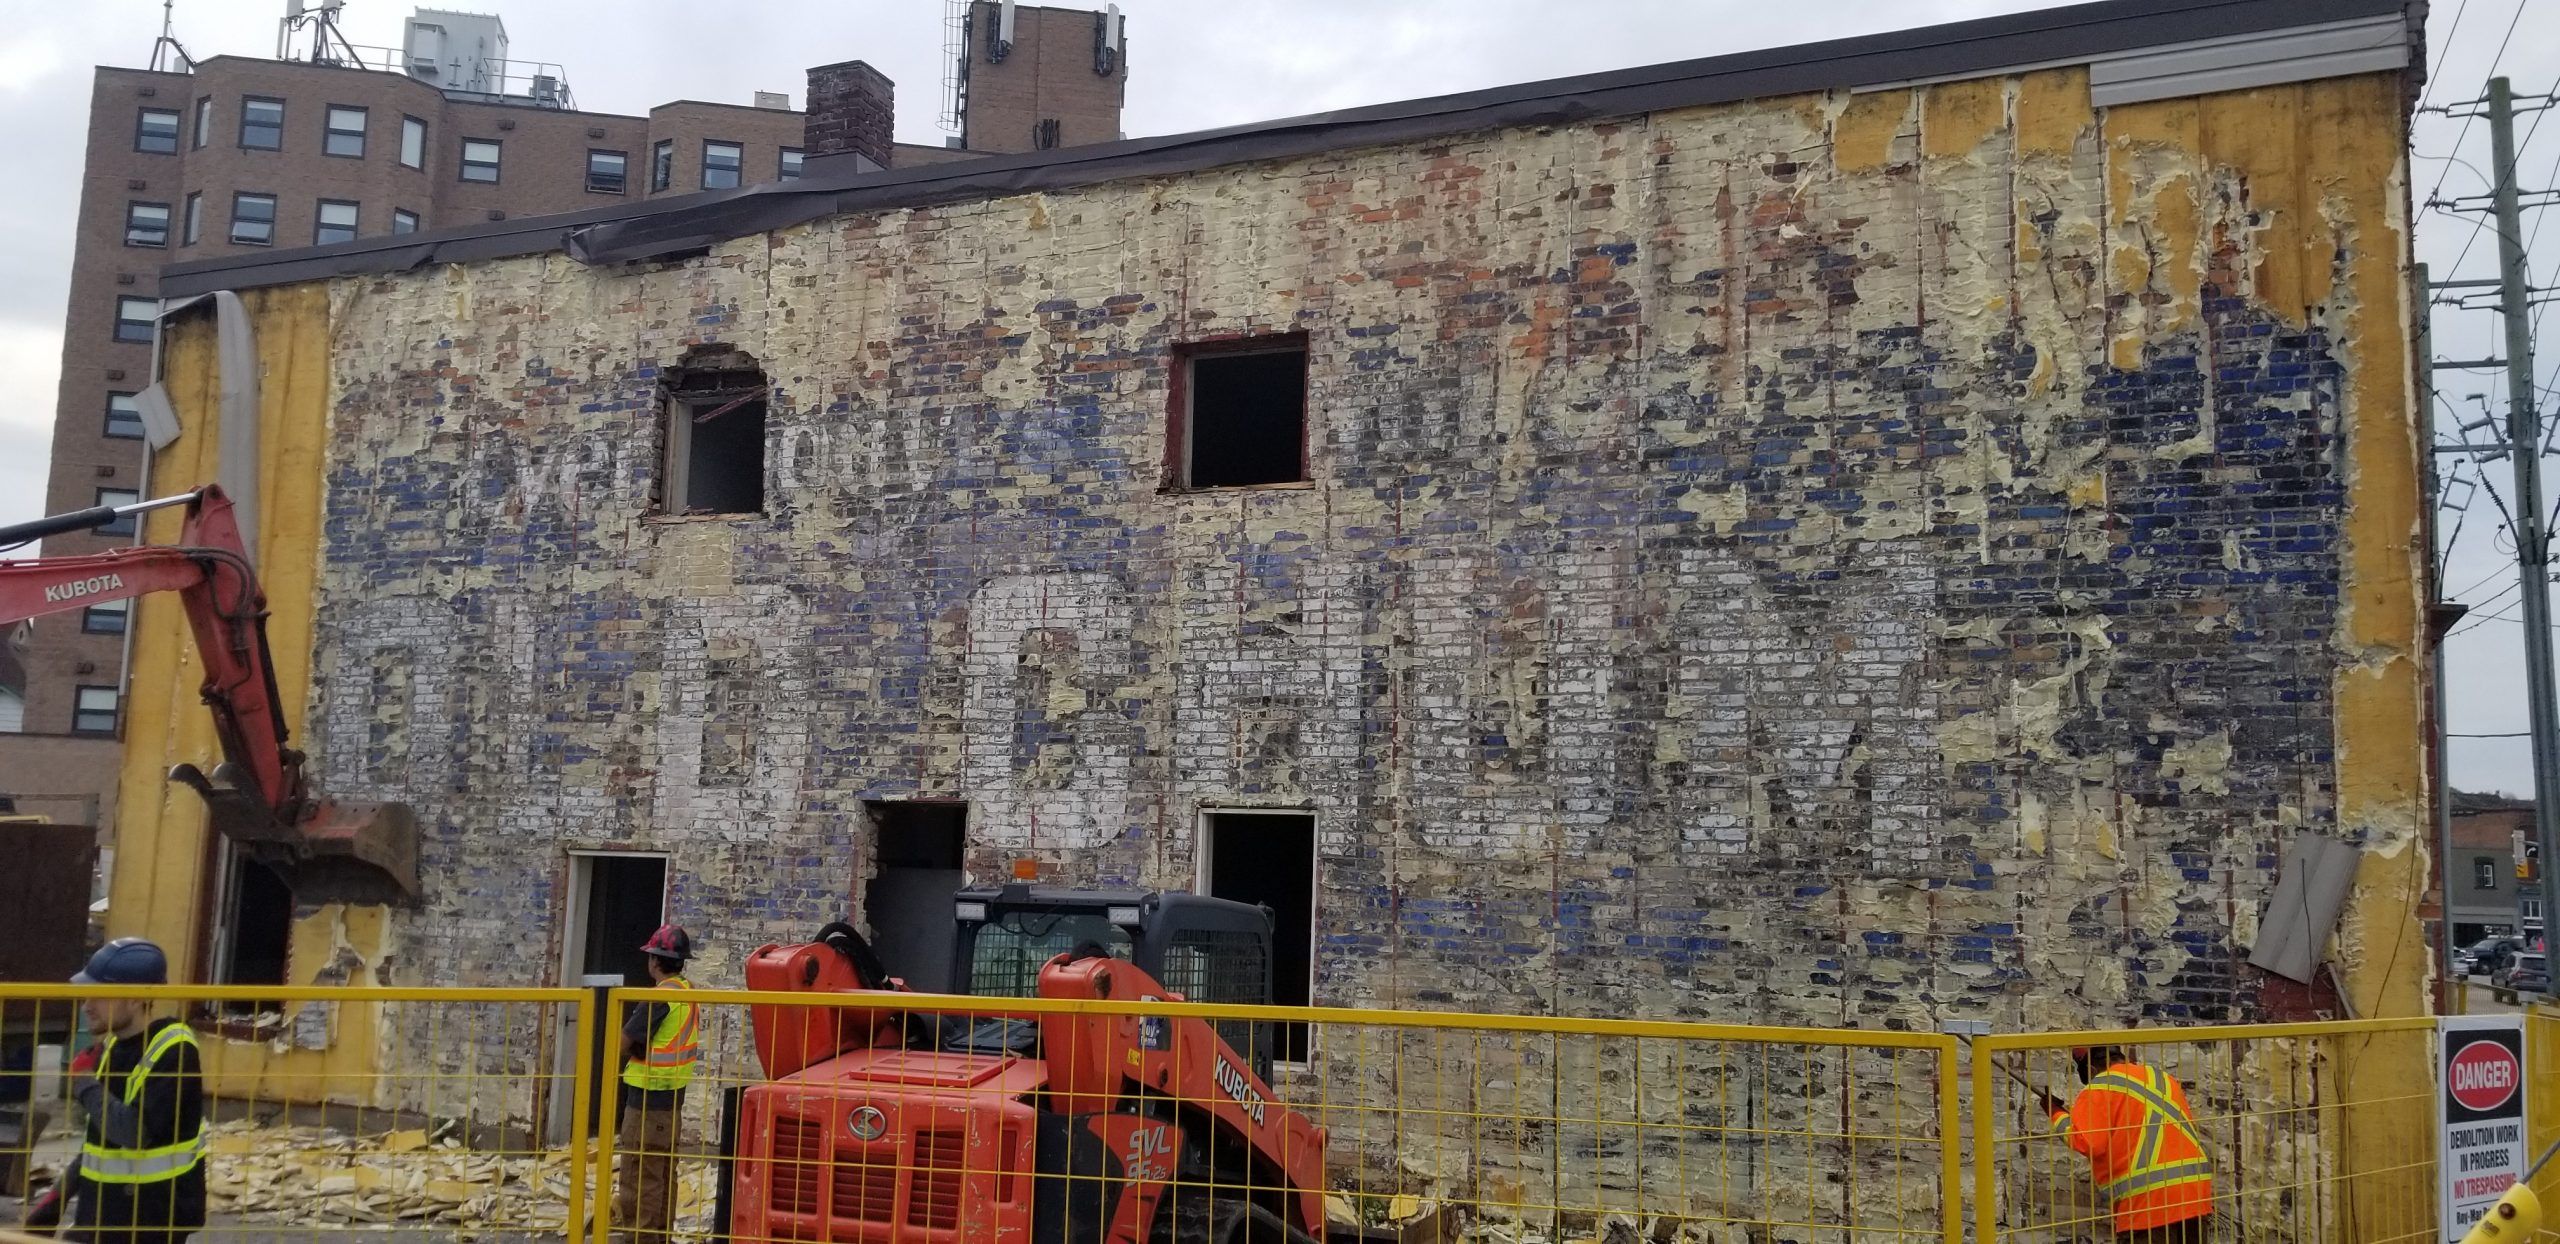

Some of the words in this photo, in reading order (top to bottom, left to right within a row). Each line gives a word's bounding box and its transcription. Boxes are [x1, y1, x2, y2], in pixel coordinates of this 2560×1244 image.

[45, 573, 124, 602] KUBOTA
[2455, 1060, 2512, 1091] DANGER
[1214, 1053, 1266, 1128] KUBOTA
[1126, 1125, 1172, 1161] SVL
[2450, 1127, 2495, 1150] DEMOLITION
[2496, 1124, 2519, 1145] WORK
[2460, 1153, 2469, 1173] IN
[2470, 1148, 2510, 1171] PROGRESS
[2454, 1179, 2465, 1200] NO
